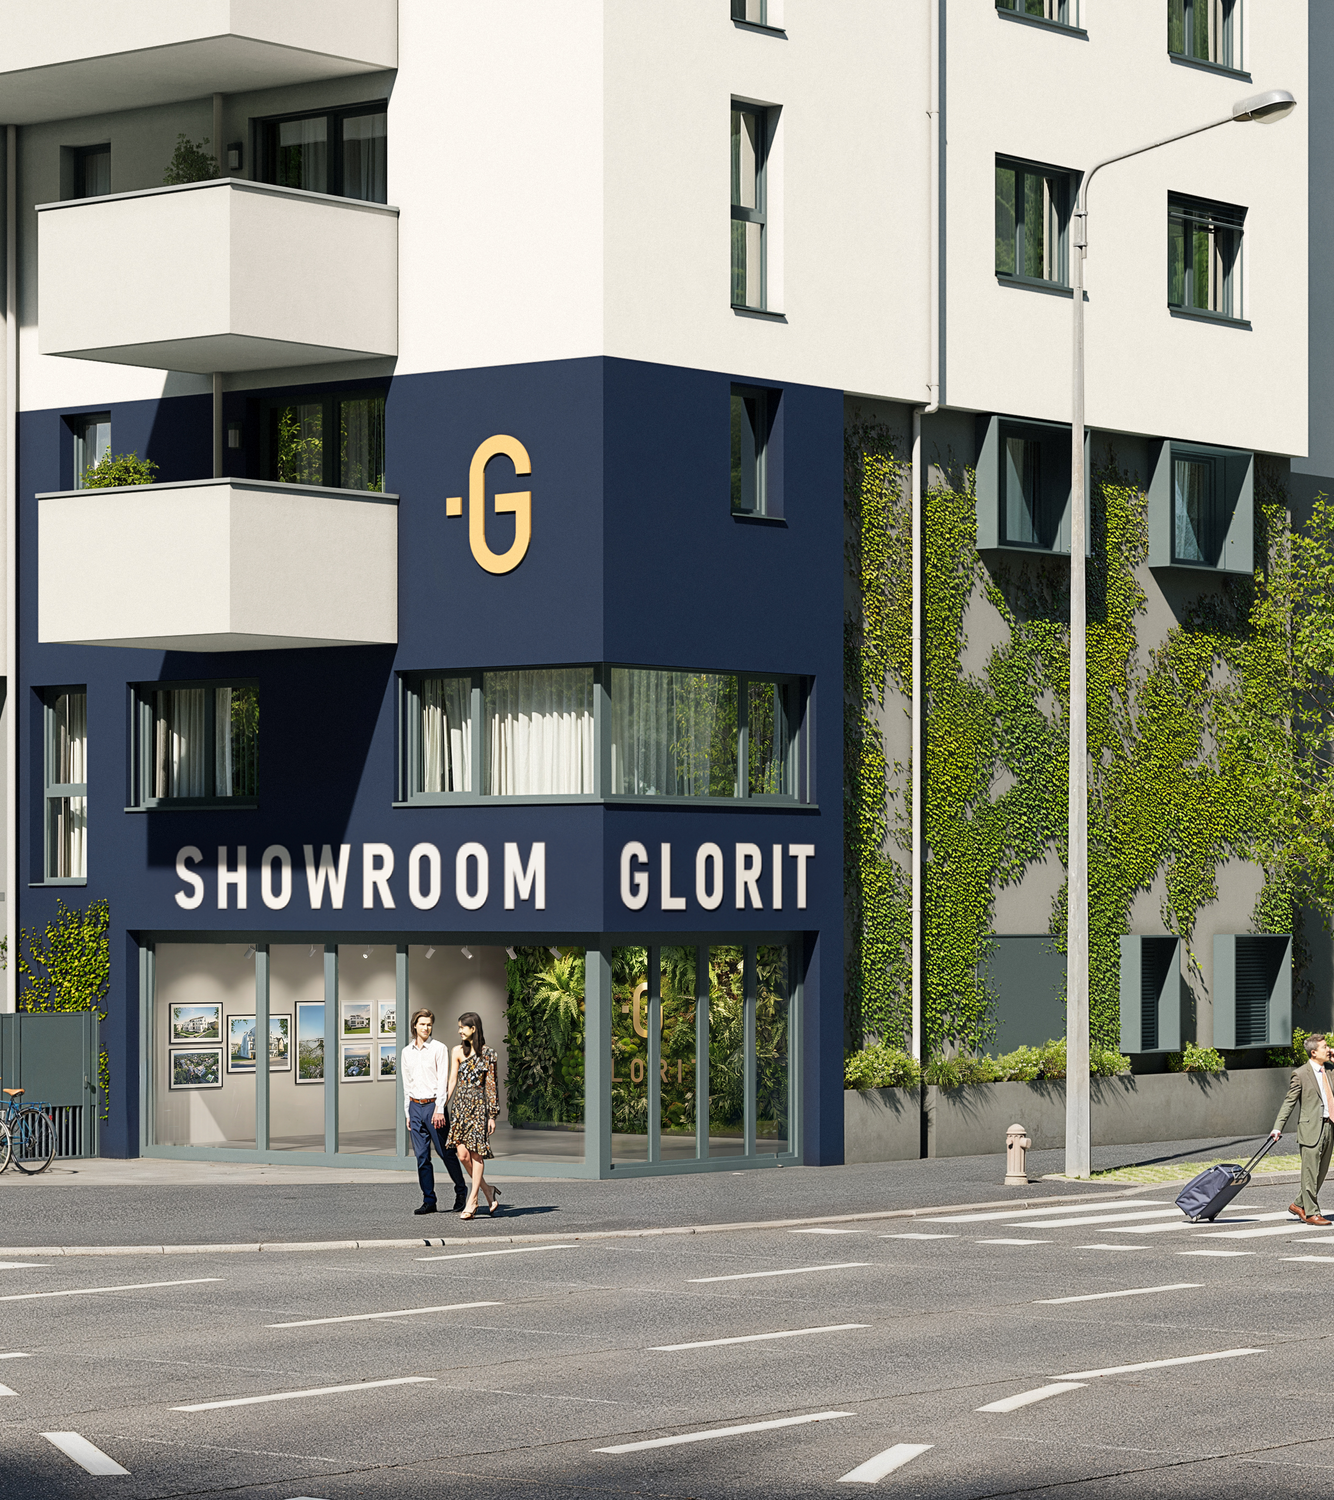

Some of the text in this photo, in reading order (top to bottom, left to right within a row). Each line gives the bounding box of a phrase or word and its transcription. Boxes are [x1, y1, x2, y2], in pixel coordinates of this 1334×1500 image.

[174, 841, 815, 911] SHOWROOM GLORIT
[611, 1058, 696, 1083] LORI
